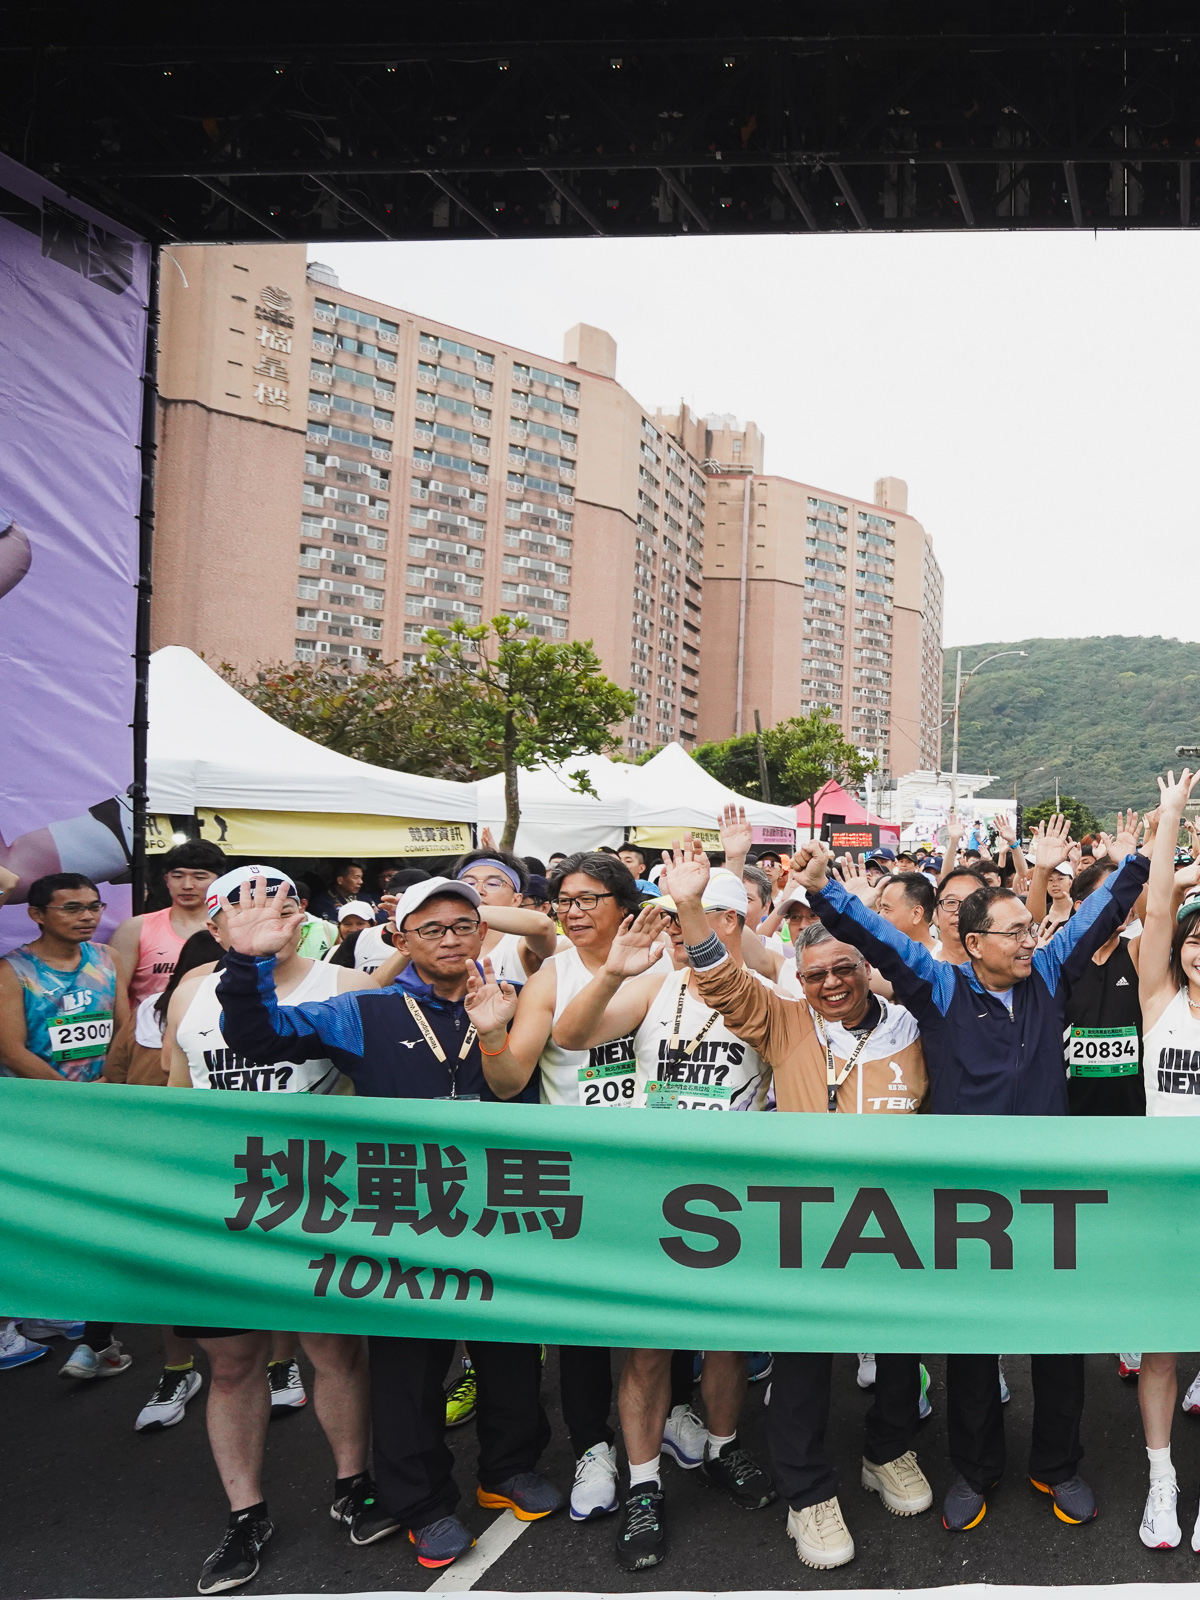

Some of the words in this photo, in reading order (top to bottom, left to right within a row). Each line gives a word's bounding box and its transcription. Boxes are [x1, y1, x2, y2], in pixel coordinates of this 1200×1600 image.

[408, 827, 463, 841] 競賽資訊
[58, 1023, 112, 1044] 23001
[1073, 1040, 1136, 1058] 20834
[867, 1097, 918, 1110] TBK
[224, 1136, 584, 1240] 挑戰馬
[659, 1183, 1108, 1270] START
[308, 1253, 494, 1301] 10km
